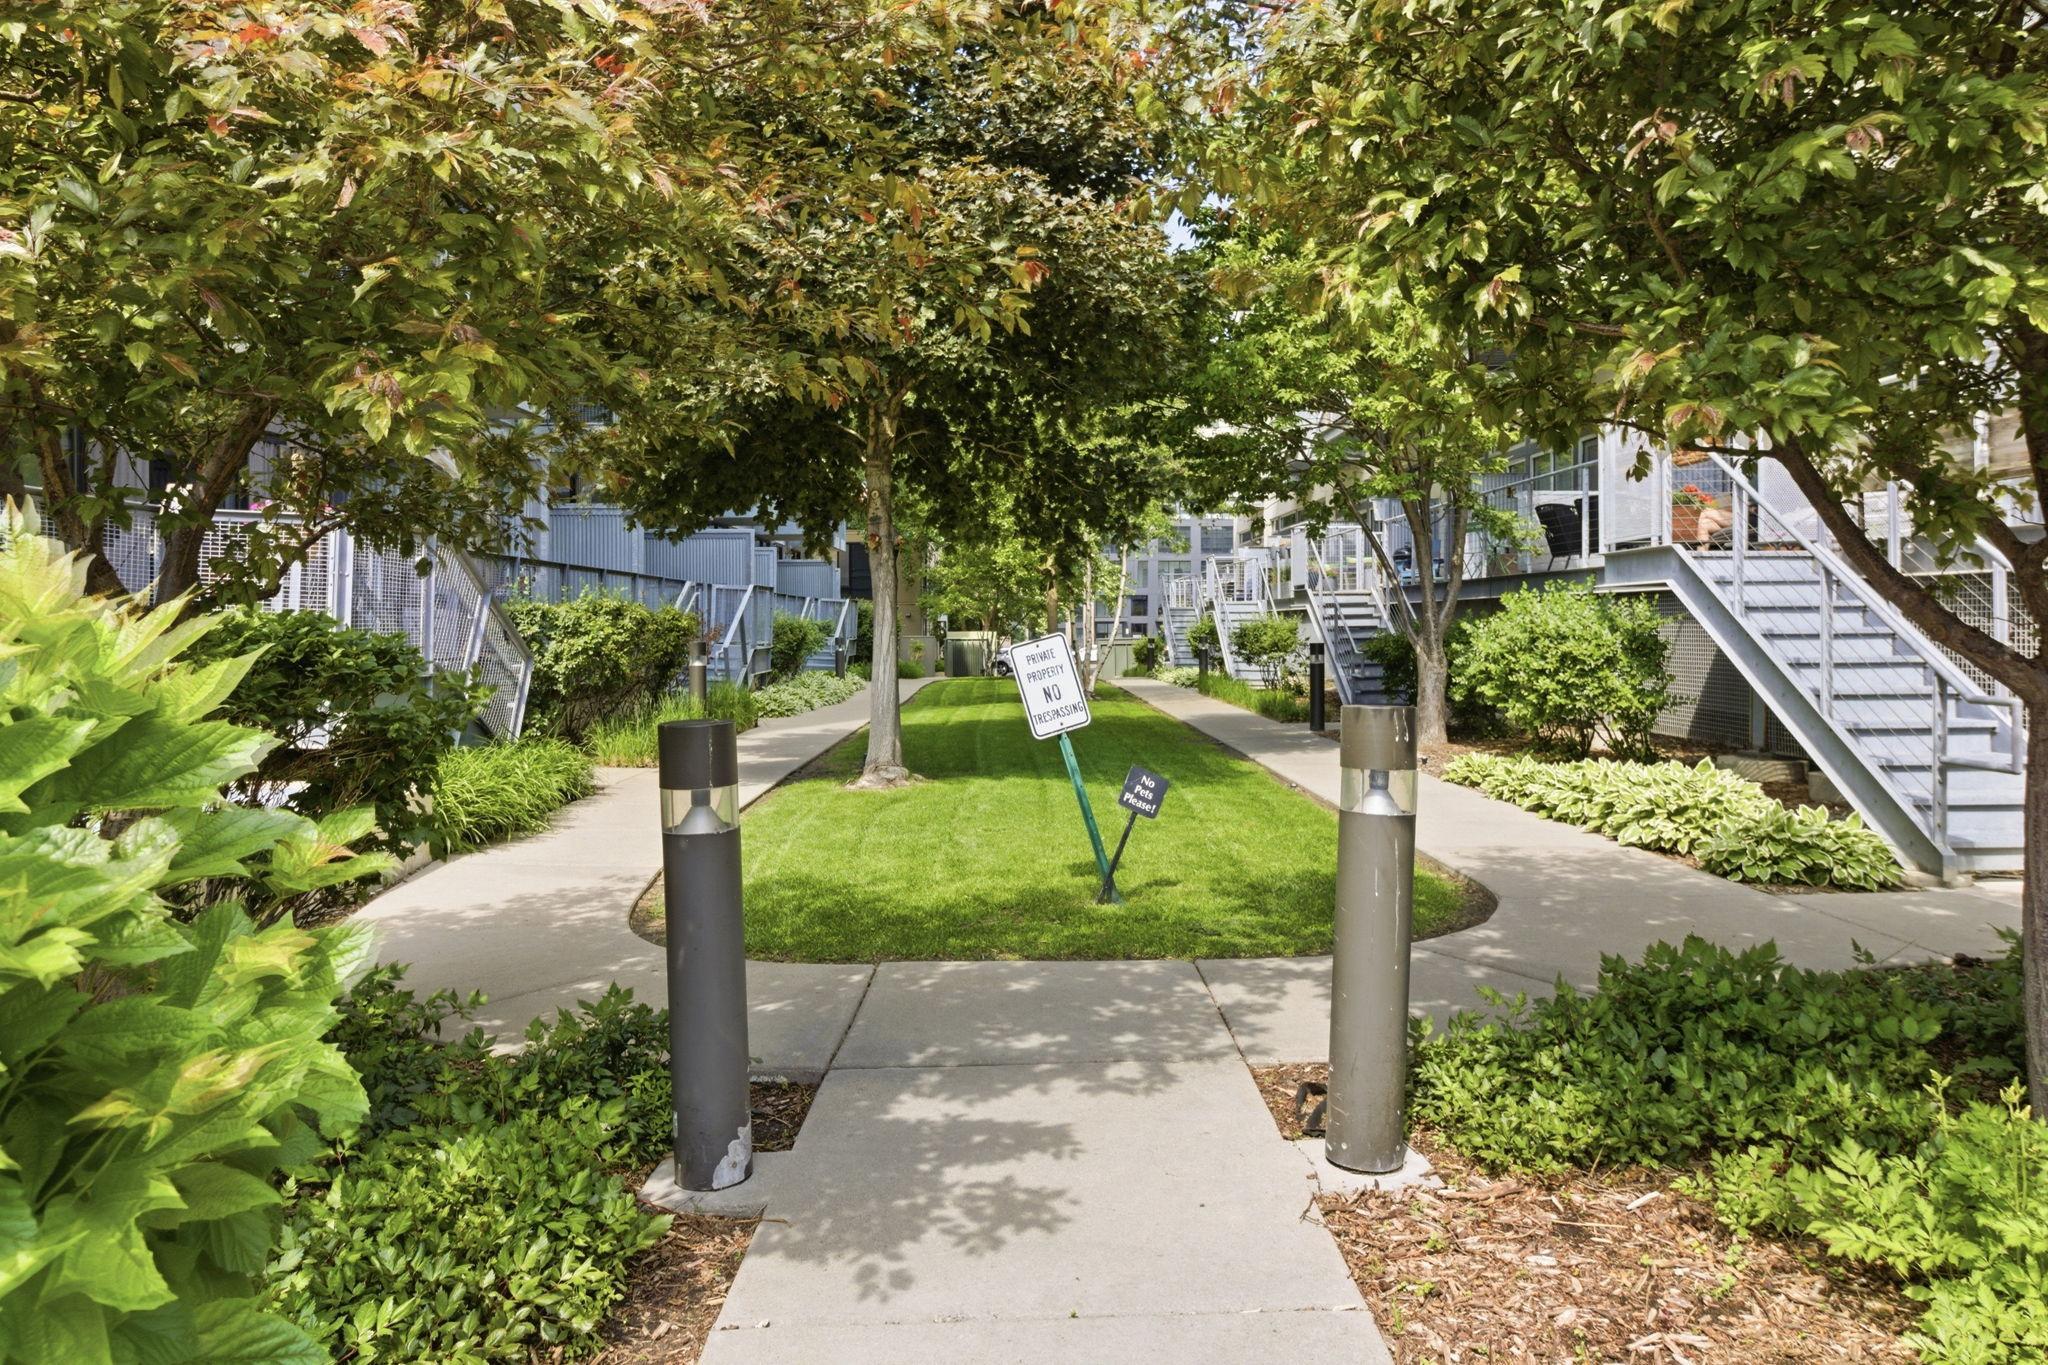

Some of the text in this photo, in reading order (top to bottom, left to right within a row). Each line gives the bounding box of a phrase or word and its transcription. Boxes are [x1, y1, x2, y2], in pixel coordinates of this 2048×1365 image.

[1026, 648, 1056, 665] PRIVATE
[1027, 665, 1064, 683] PROPERTY
[1042, 684, 1061, 703] NO
[1033, 701, 1084, 725] TRESPASSING
[1140, 775, 1155, 789] No
[1134, 785, 1153, 800] Pets
[1123, 792, 1156, 814] Please!
